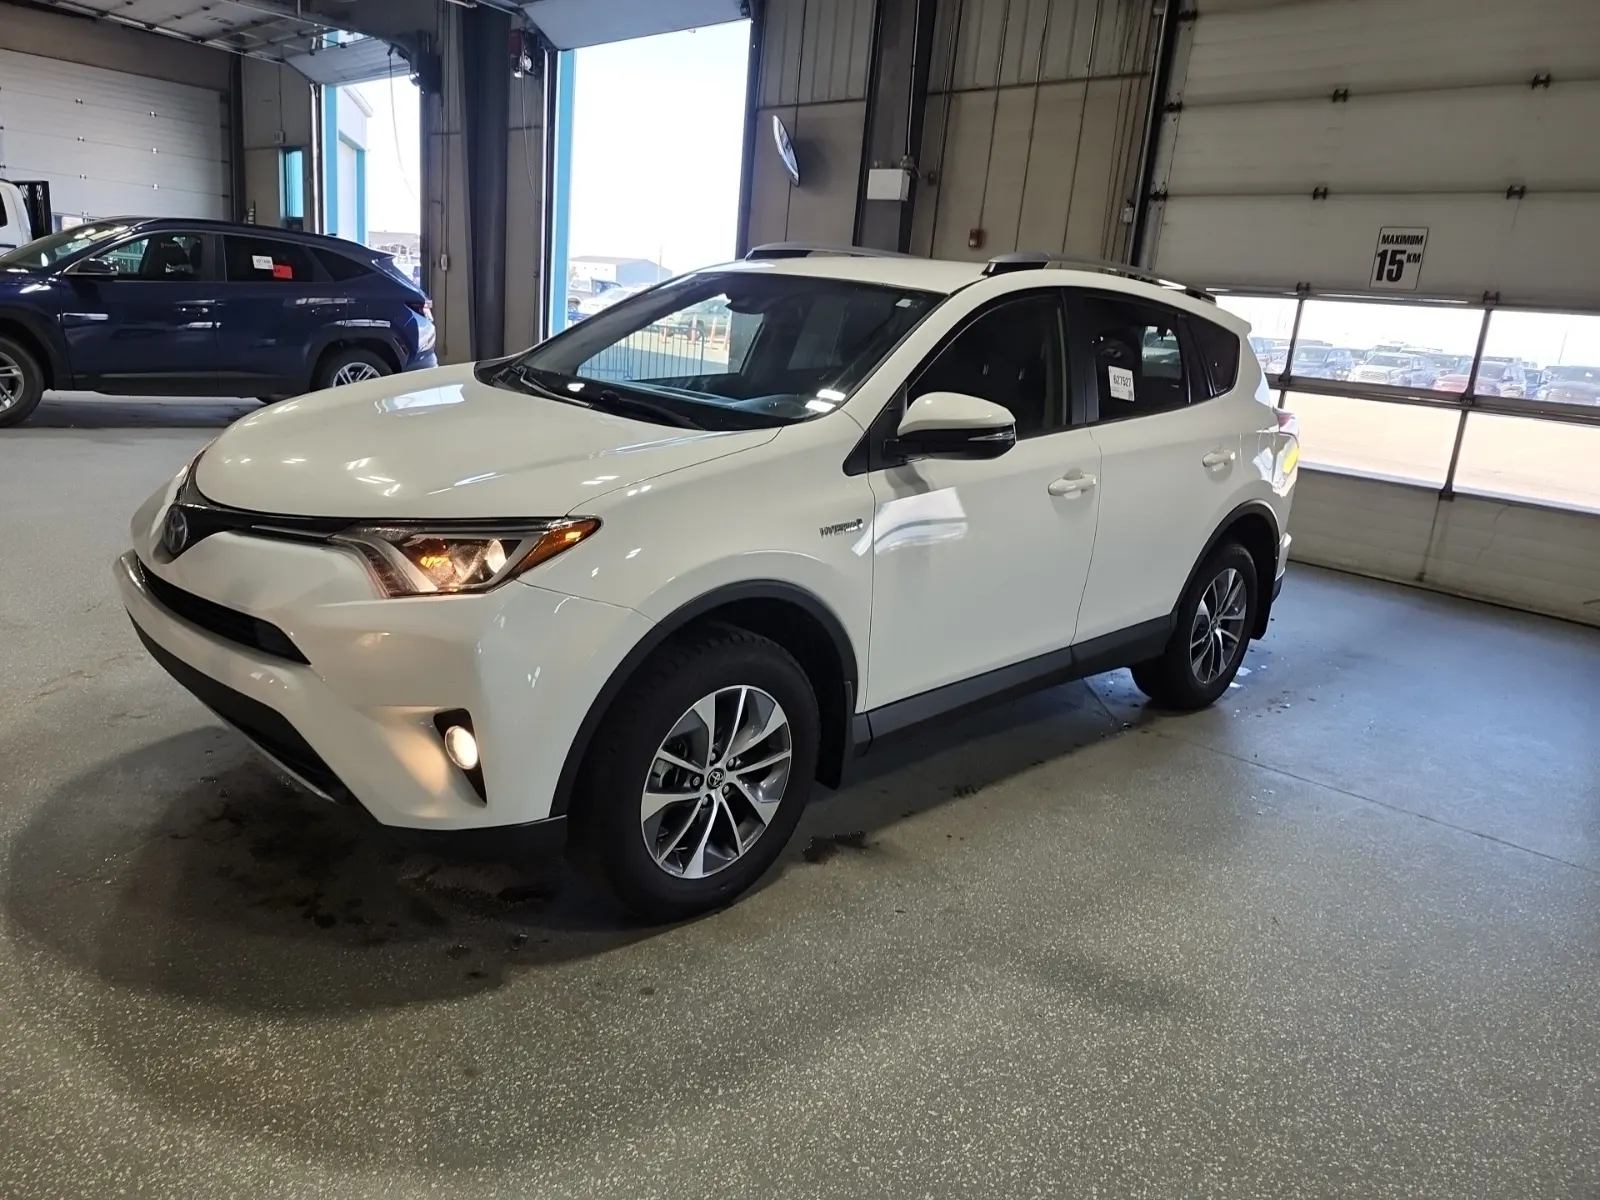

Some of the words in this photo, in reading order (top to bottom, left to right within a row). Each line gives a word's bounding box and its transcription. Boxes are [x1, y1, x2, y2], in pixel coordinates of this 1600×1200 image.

[1380, 234, 1424, 245] MAXIMUM
[1376, 249, 1407, 283] 15
[1406, 252, 1422, 264] KM
